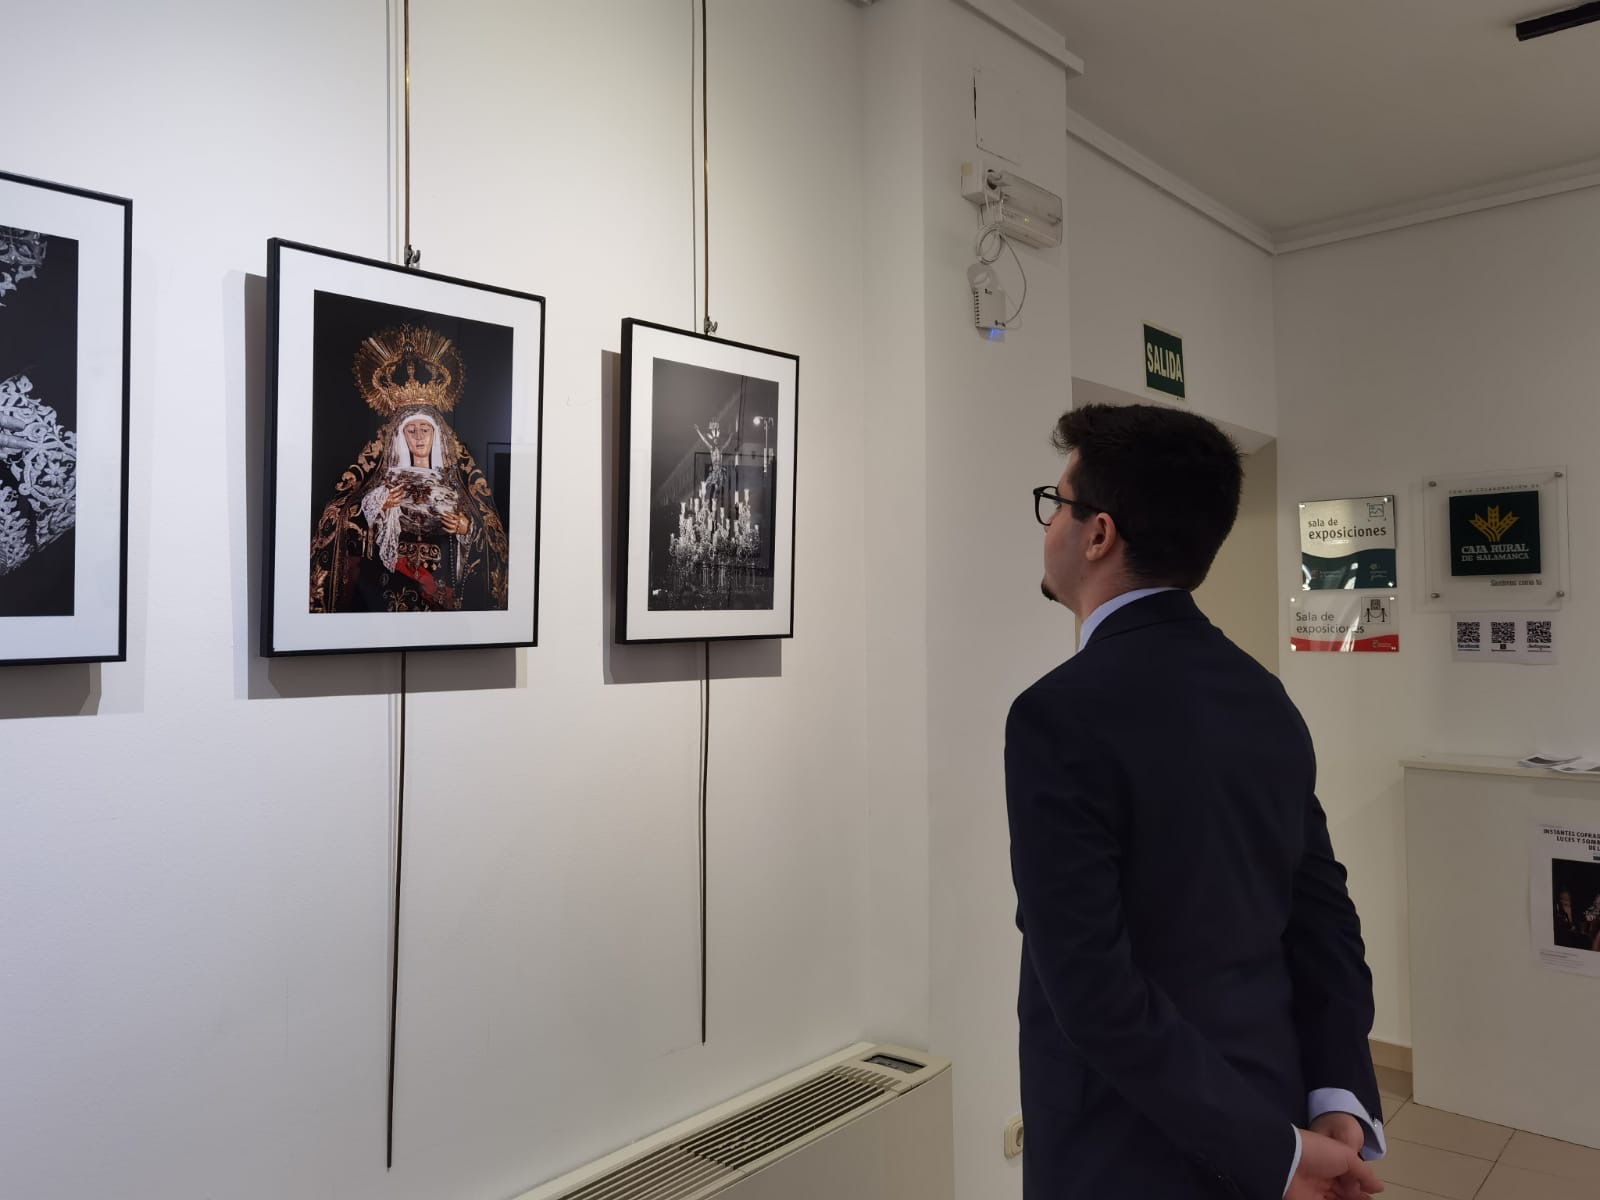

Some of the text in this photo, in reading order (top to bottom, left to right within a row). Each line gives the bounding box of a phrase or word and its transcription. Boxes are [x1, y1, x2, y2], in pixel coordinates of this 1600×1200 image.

[1146, 342, 1184, 383] SALIDA
[1308, 518, 1339, 527] sala de
[1308, 525, 1387, 542] exposiciones
[1461, 543, 1529, 554] CAJA RURAL
[1461, 552, 1530, 562] DE SALAMANCA
[1296, 611, 1335, 622] Sala de
[1296, 623, 1365, 636] exposicioes
